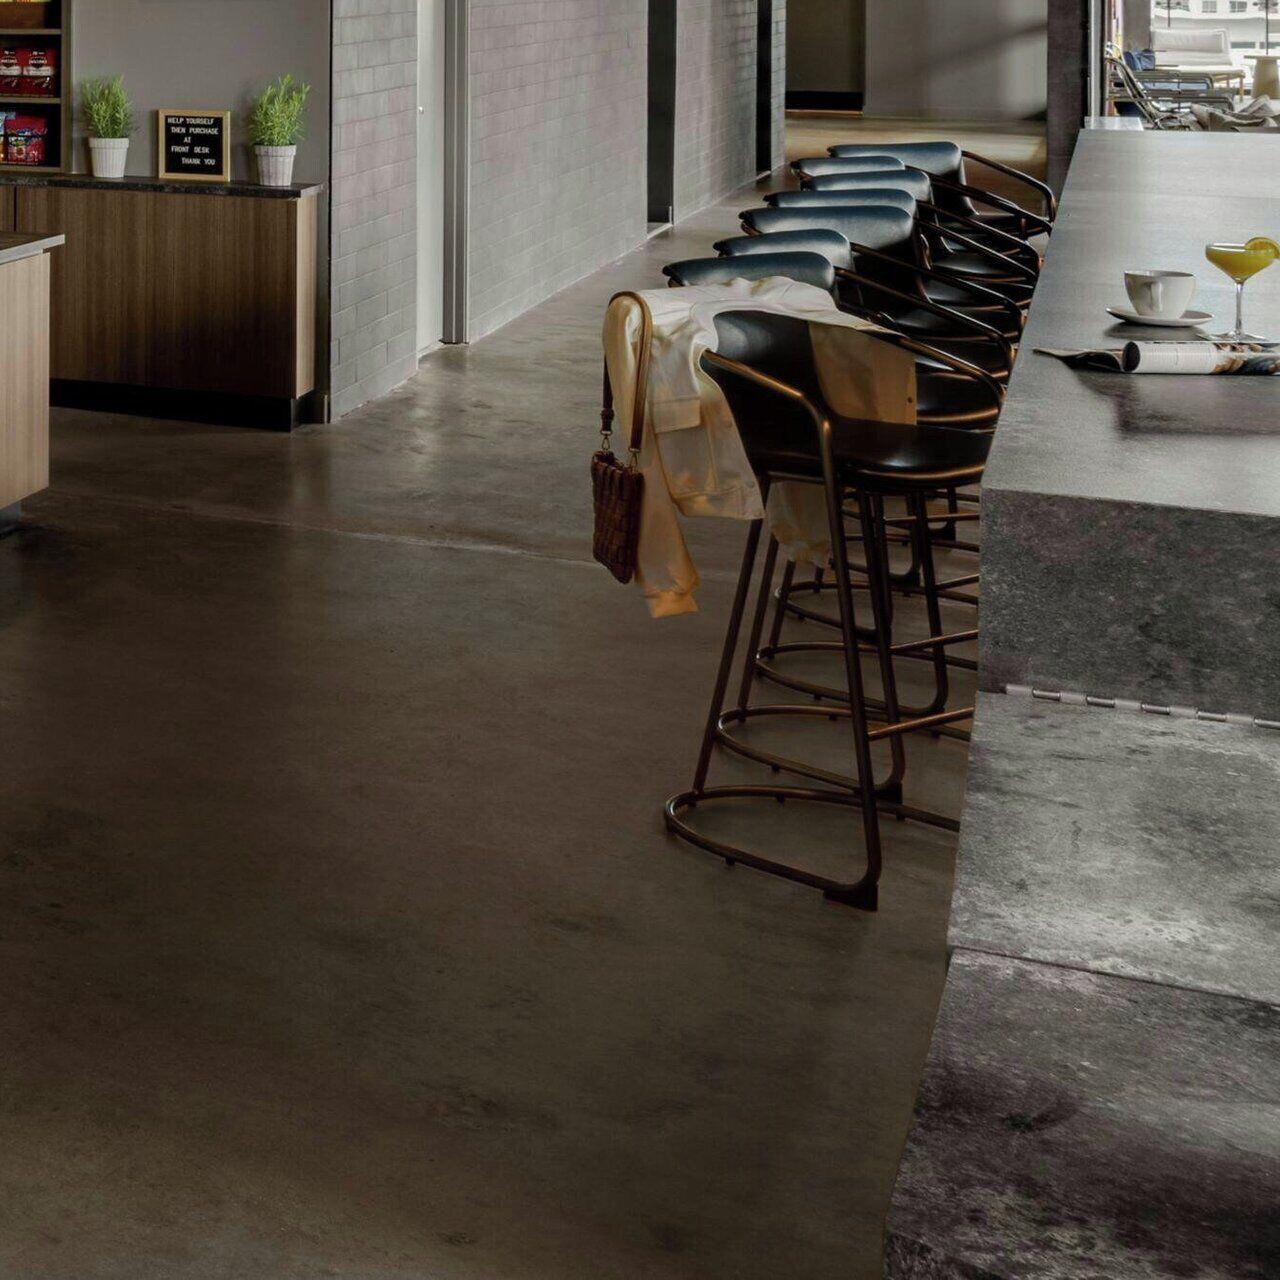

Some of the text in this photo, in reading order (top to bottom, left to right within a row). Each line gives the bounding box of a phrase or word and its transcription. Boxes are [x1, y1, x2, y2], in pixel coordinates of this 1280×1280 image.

[171, 126, 219, 135] THEN PURCHASE
[183, 136, 192, 144] AT
[171, 145, 210, 154] FRONT DESK
[181, 157, 216, 166] THANK YOU
